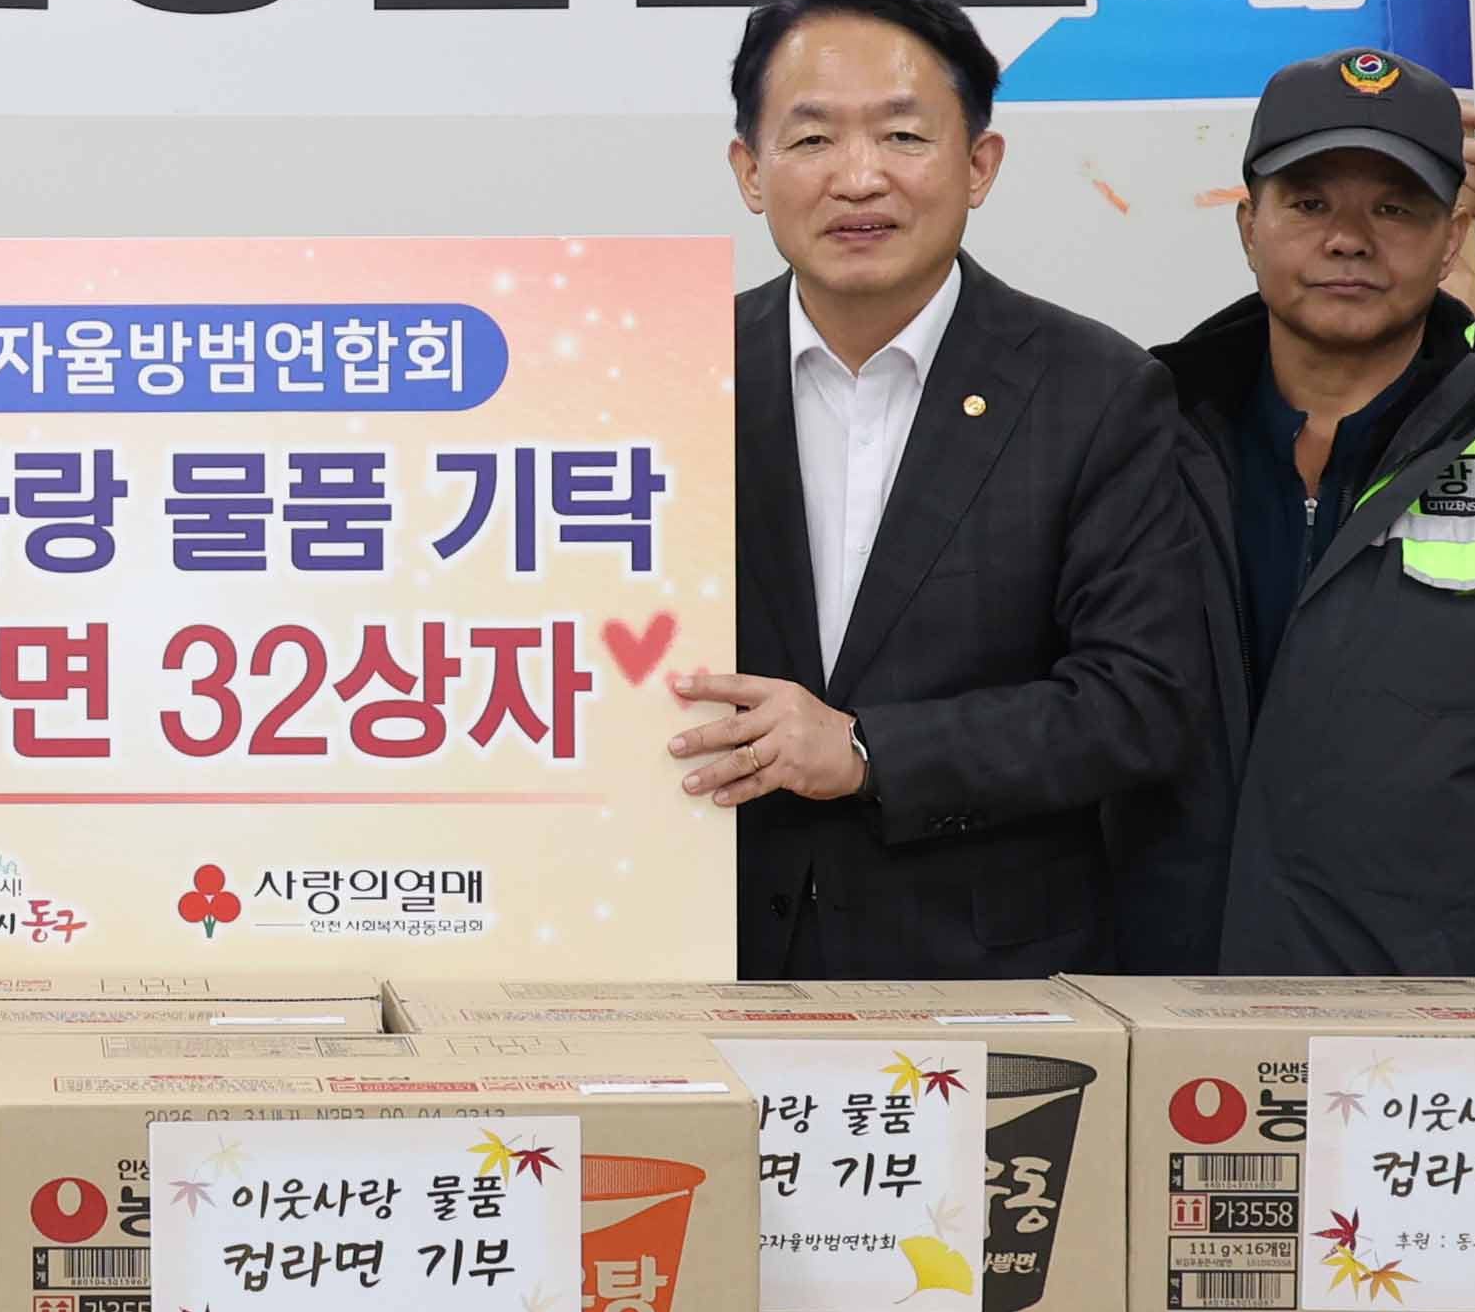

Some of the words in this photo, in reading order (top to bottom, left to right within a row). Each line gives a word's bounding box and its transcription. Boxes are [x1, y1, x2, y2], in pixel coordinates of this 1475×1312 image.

[163, 447, 393, 573] 물품
[433, 446, 666, 572] 기탁
[159, 619, 593, 758] 32상자
[253, 869, 484, 914] 사랑의열매
[21, 899, 88, 943] 동구
[309, 920, 339, 935] 인천
[344, 920, 484, 936] 사회복지공동모금회
[841, 1093, 915, 1136] 물품
[831, 1152, 923, 1198] 기부
[232, 1178, 402, 1222] 이웃사랑
[426, 1175, 507, 1221] 물품
[1214, 1200, 1294, 1230] 가3558
[223, 1239, 384, 1292] 컵라면
[417, 1238, 515, 1287] 기부
